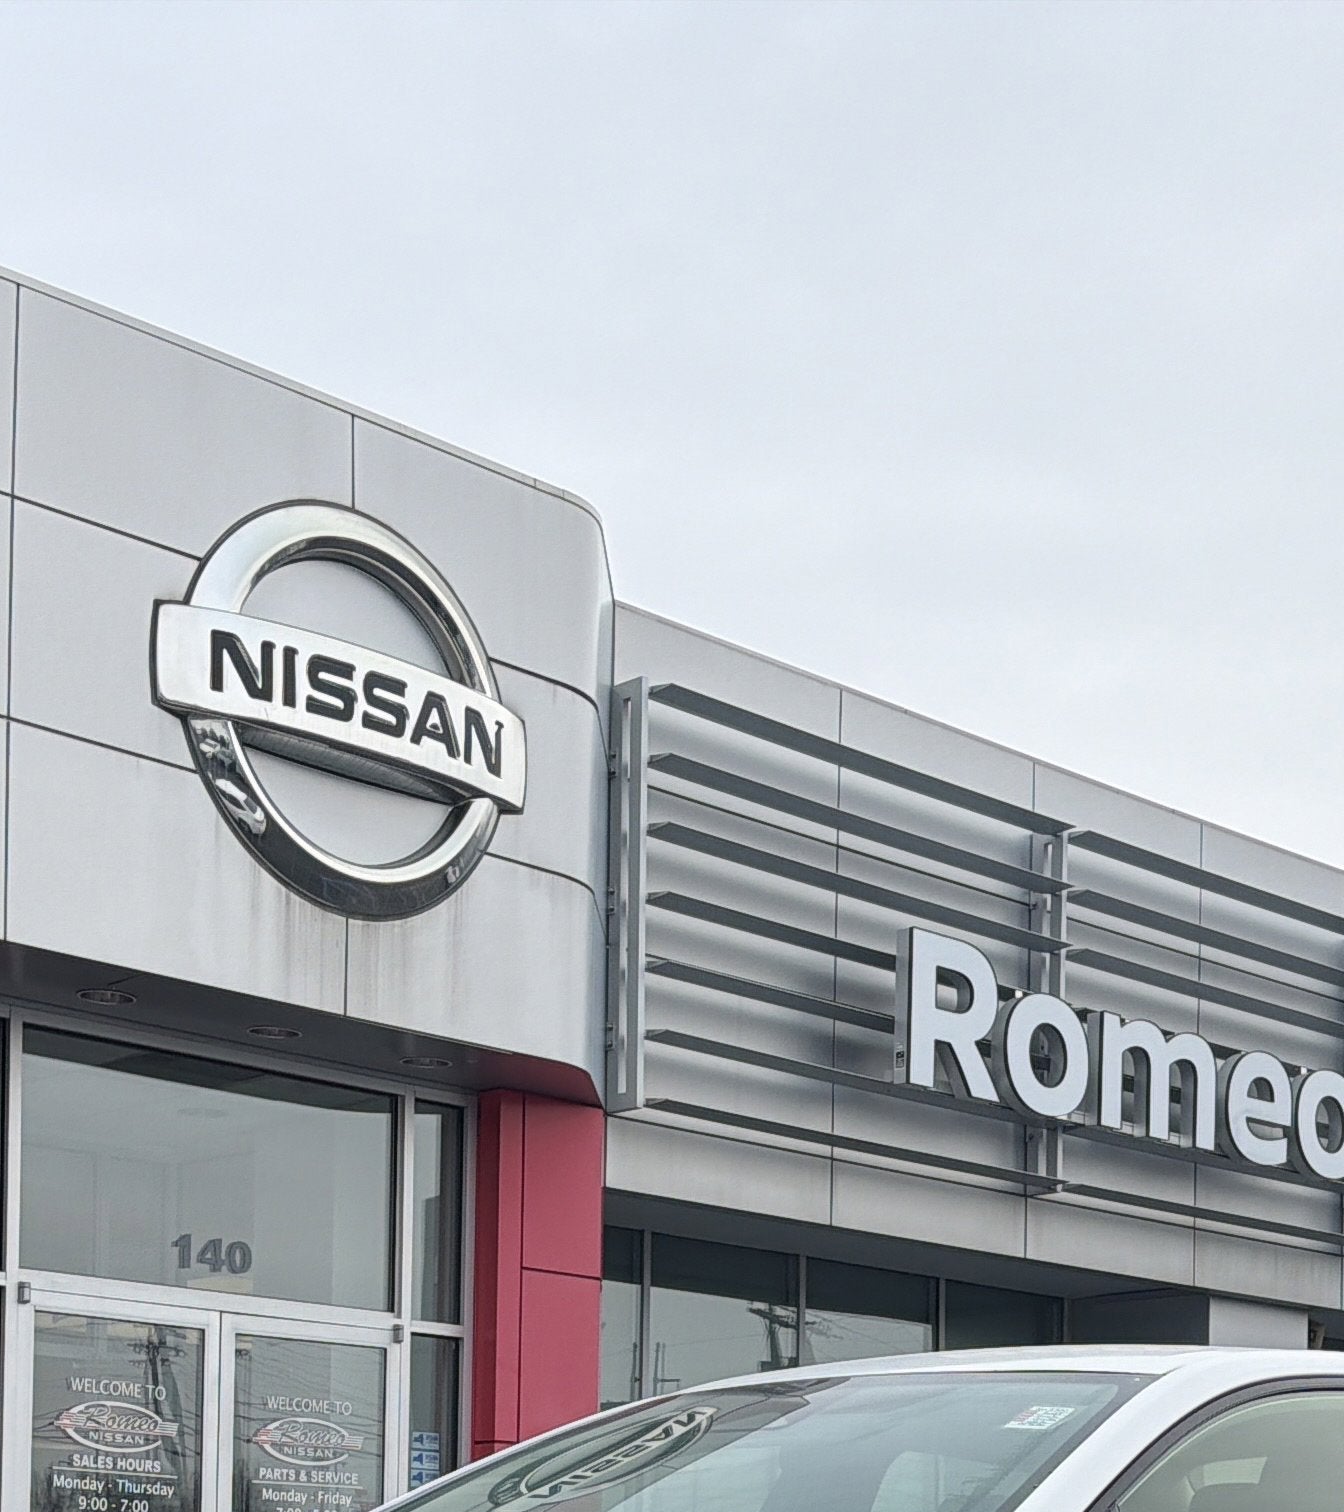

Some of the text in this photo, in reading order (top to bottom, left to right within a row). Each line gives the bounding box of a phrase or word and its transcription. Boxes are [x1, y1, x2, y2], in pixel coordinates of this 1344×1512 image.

[209, 628, 505, 779] NISSAN
[170, 1233, 253, 1275] 140
[71, 1376, 167, 1401] WELCOME TO
[266, 1394, 353, 1416] WELCOME TO
[82, 1403, 160, 1433] Romeo
[89, 1430, 145, 1445] NISSAN
[276, 1420, 346, 1446] Romeo
[72, 1453, 162, 1473] SALES HOURS
[283, 1446, 334, 1458] NISSAN
[52, 1474, 105, 1495] Monday
[116, 1478, 176, 1499] Thursday
[259, 1467, 359, 1485] PARTS & SERVICE
[78, 1495, 108, 1512] 9:00
[262, 1487, 308, 1506] Monday
[317, 1490, 353, 1507] Friday
